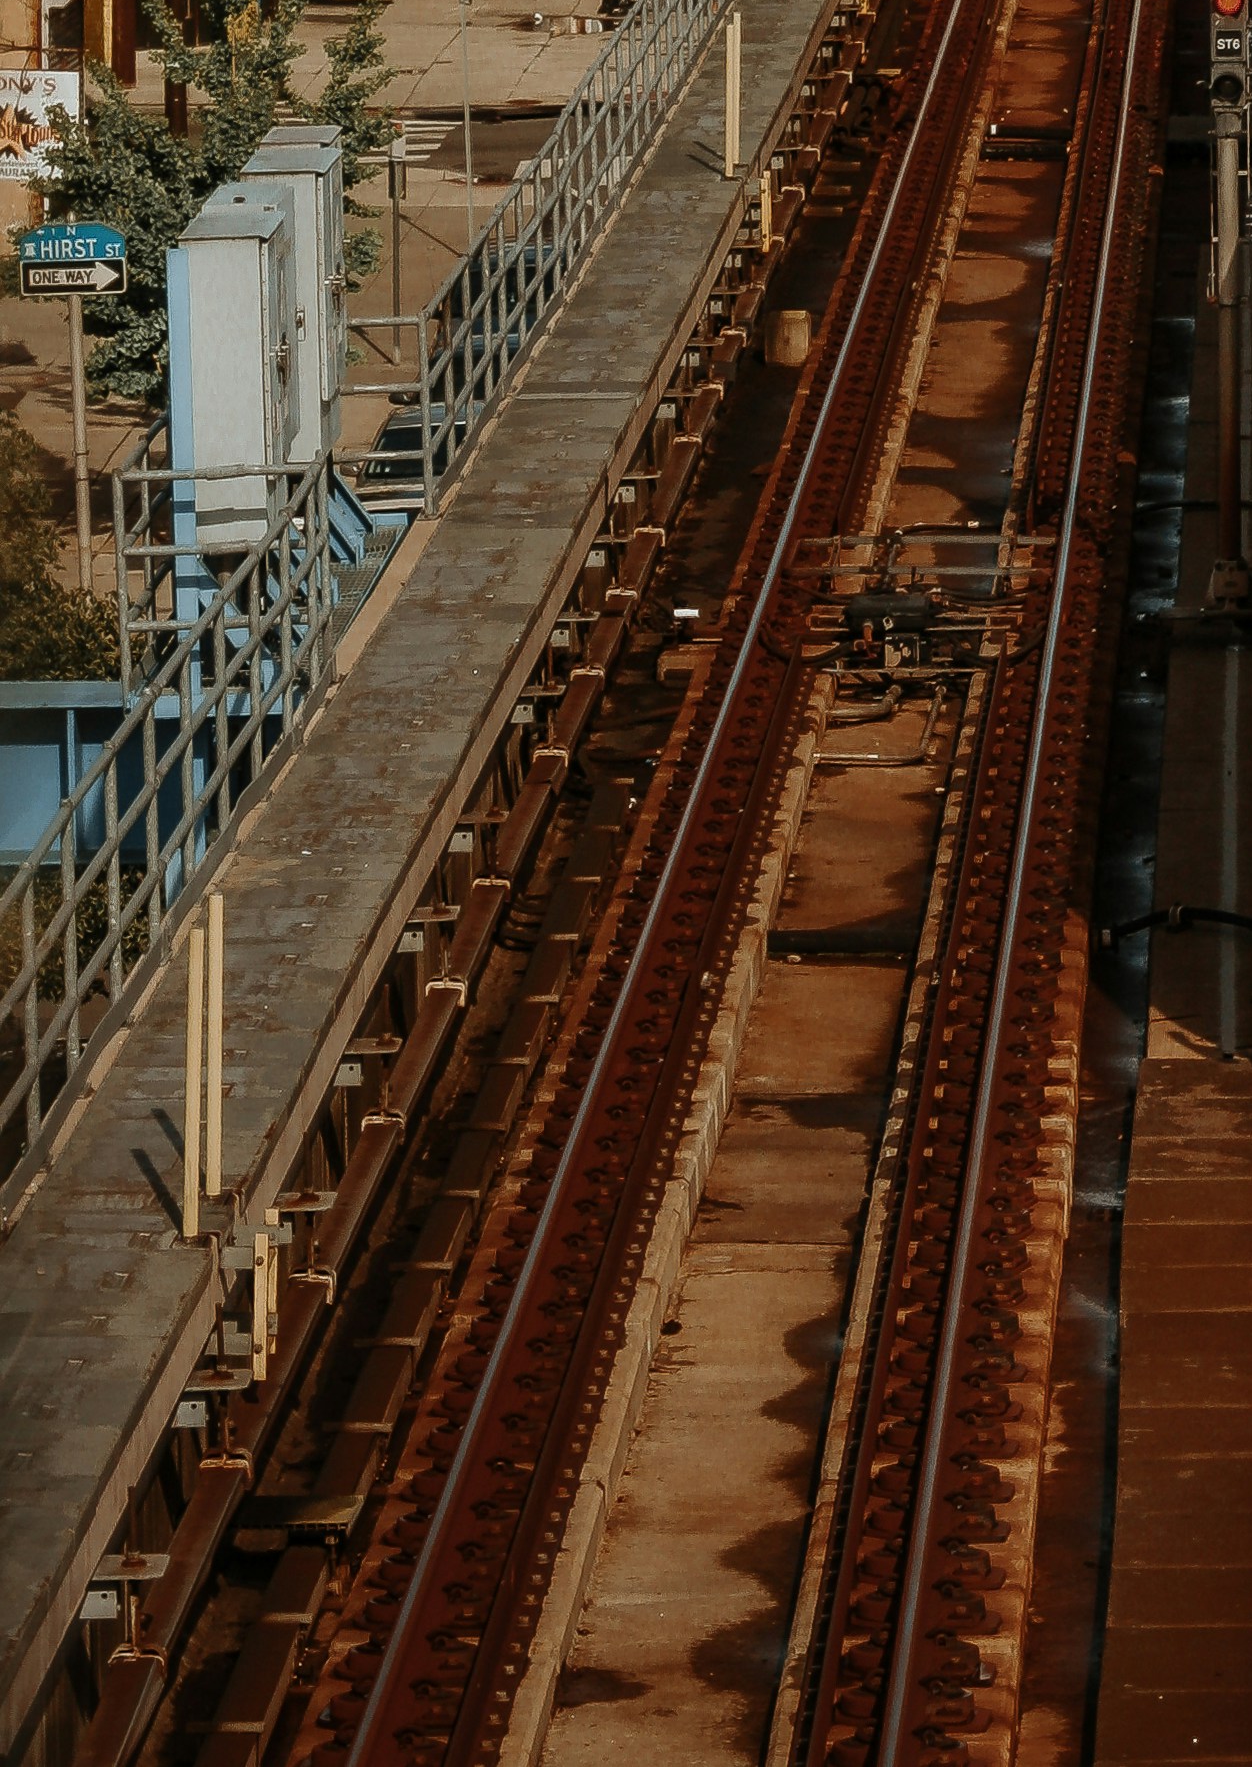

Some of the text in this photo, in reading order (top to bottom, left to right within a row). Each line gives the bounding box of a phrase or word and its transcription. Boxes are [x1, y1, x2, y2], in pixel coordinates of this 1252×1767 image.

[1216, 38, 1241, 50] ST6
[66, 226, 76, 235] N
[40, 237, 121, 258] HIRST ST
[32, 270, 93, 284] ONE WAY
